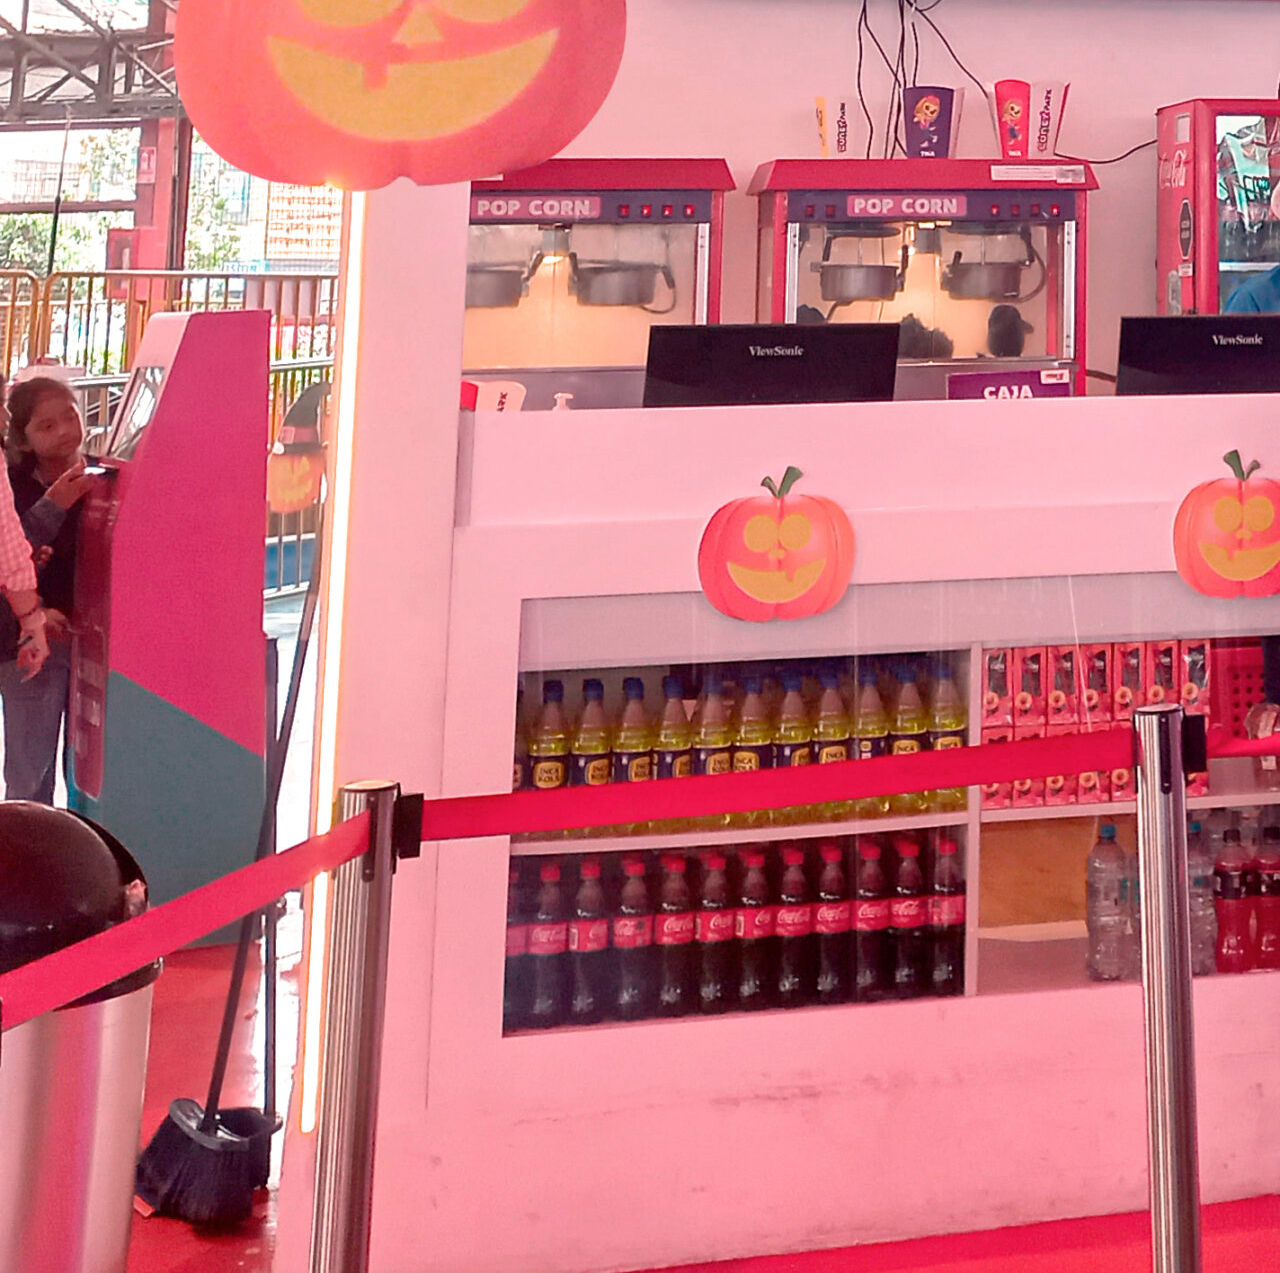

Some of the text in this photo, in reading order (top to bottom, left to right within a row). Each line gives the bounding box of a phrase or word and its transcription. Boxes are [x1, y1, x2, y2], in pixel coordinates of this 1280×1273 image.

[477, 199, 591, 217] POP CORN
[853, 197, 958, 214] POP CORN
[1212, 333, 1264, 346] ViewSonic
[749, 345, 804, 357] ViewSonic
[983, 384, 1034, 399] CAJA
[538, 766, 561, 776] INCA
